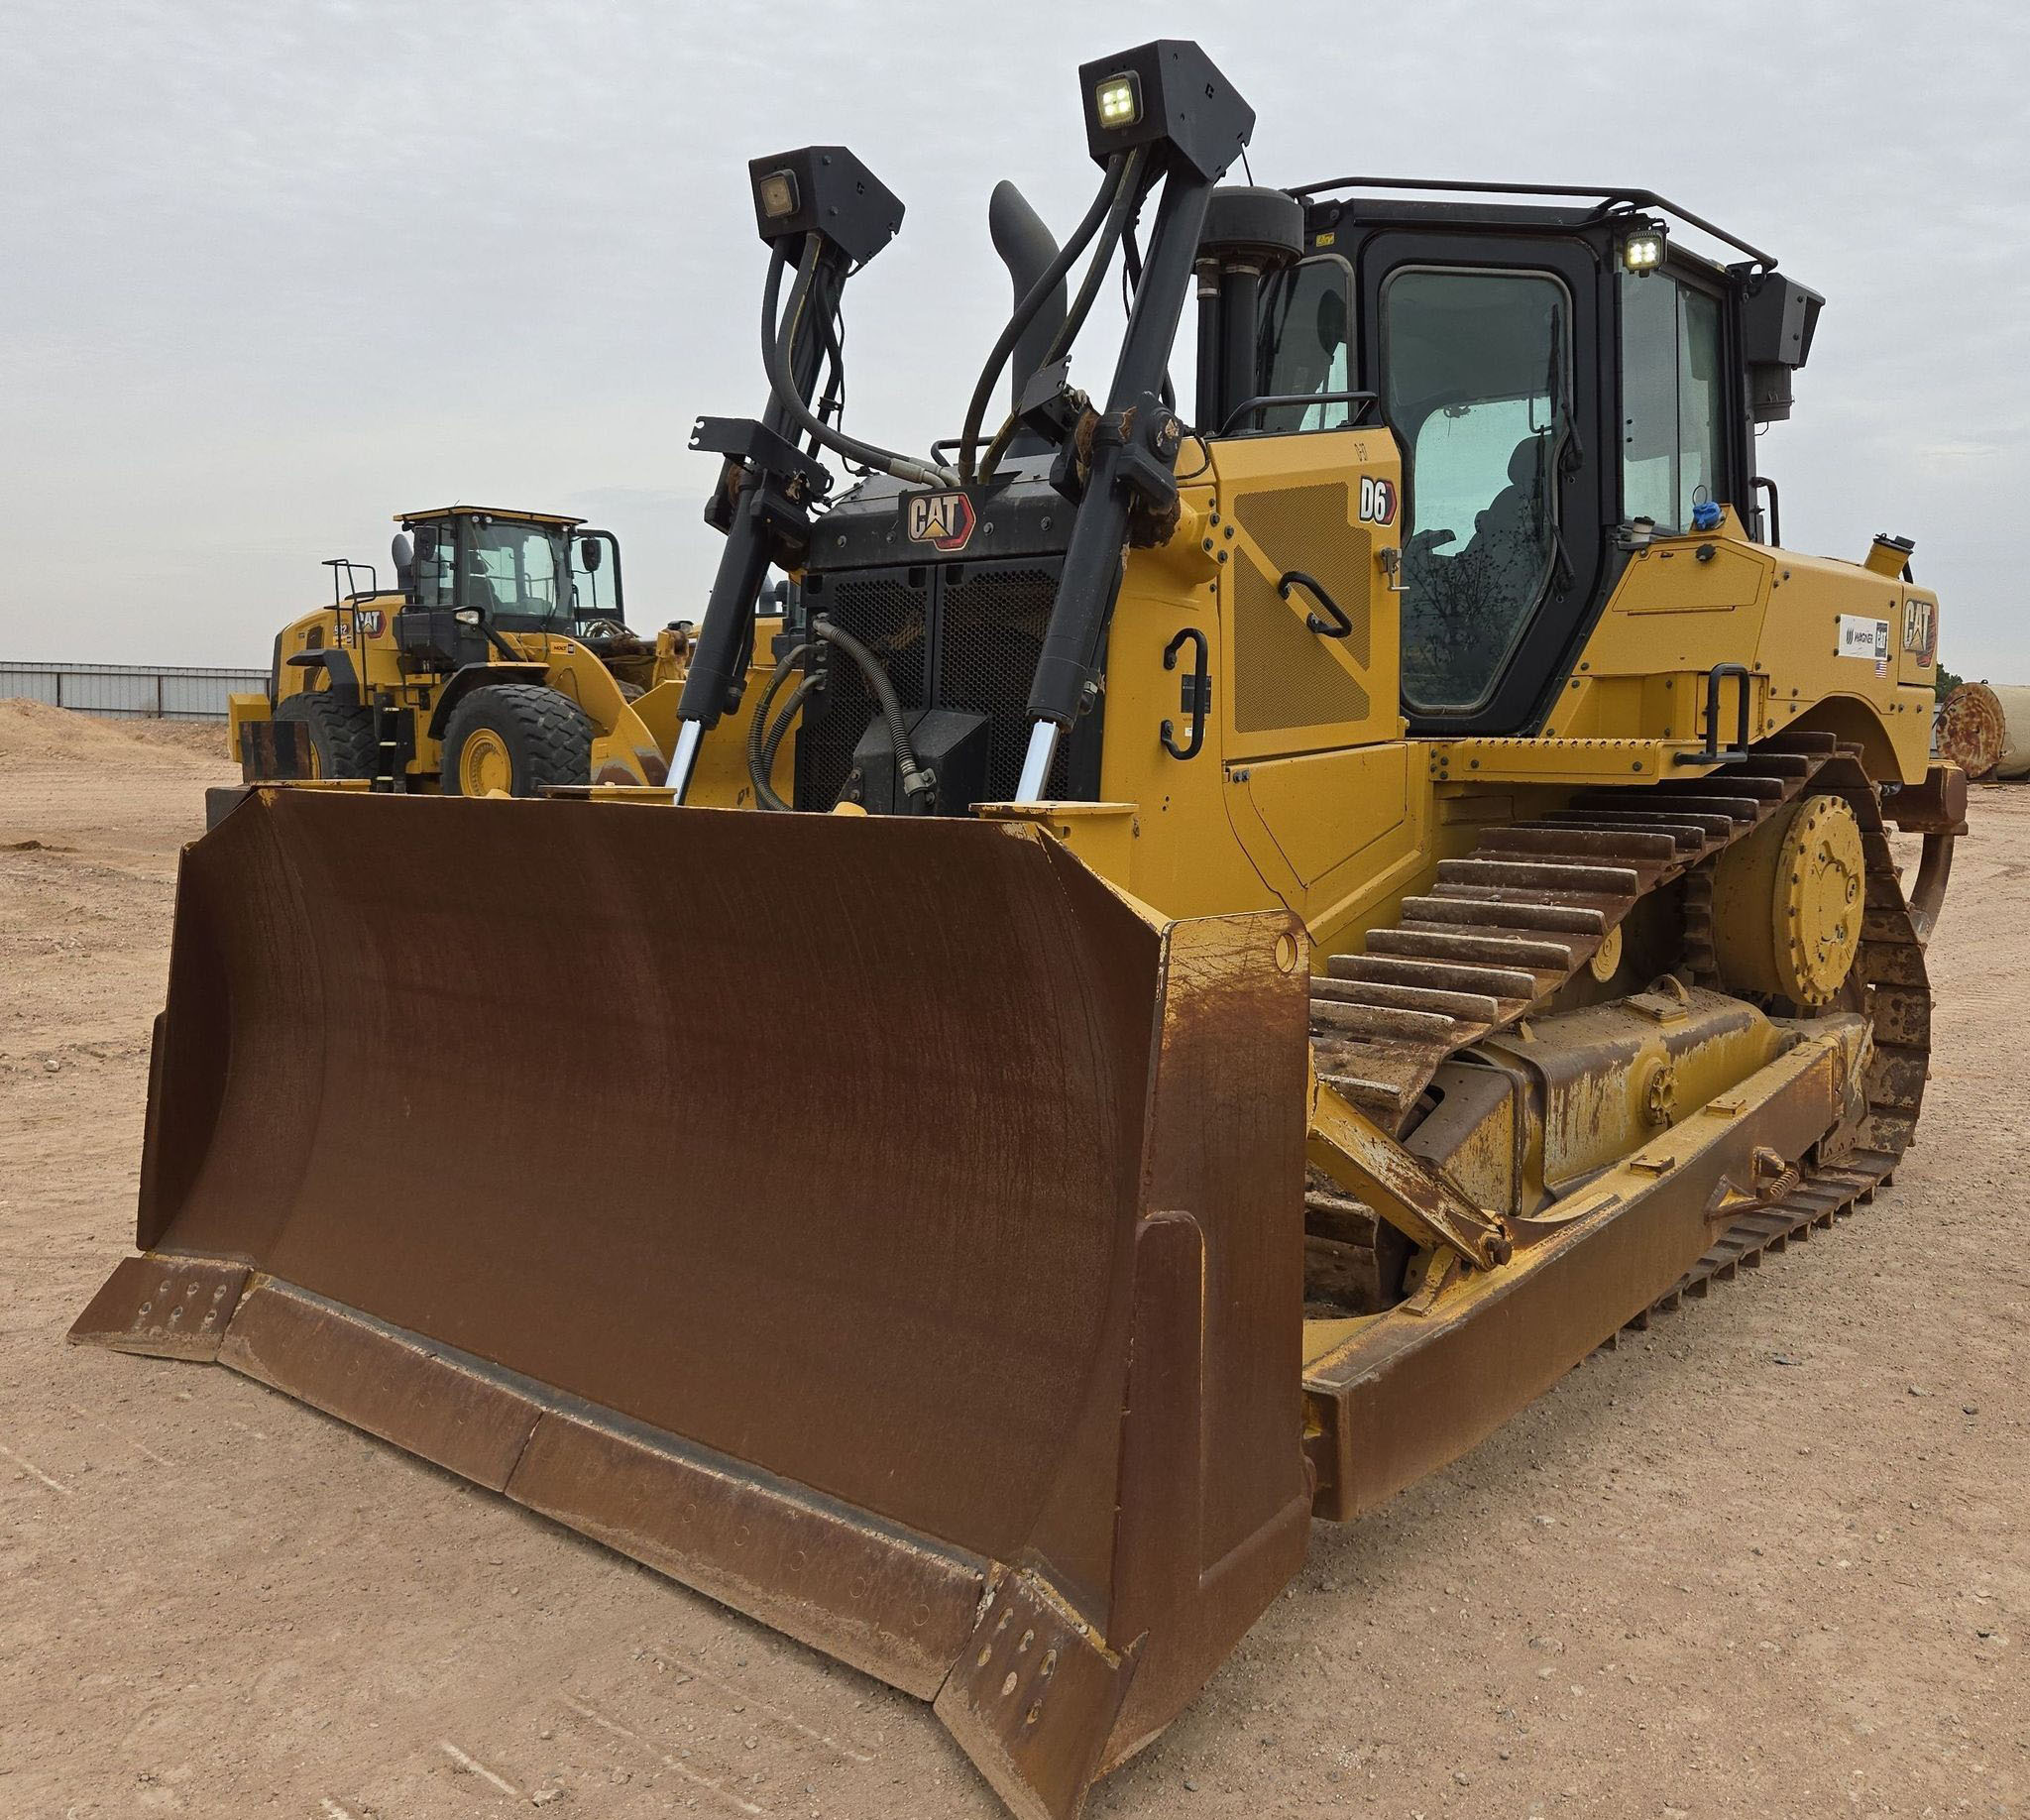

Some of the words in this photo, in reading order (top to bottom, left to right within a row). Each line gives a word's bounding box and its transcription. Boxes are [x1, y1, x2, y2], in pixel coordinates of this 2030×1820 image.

[910, 495, 959, 539] CAT
[1360, 478, 1387, 521] D6
[356, 611, 381, 634] CAT
[1904, 600, 1932, 651] CAT
